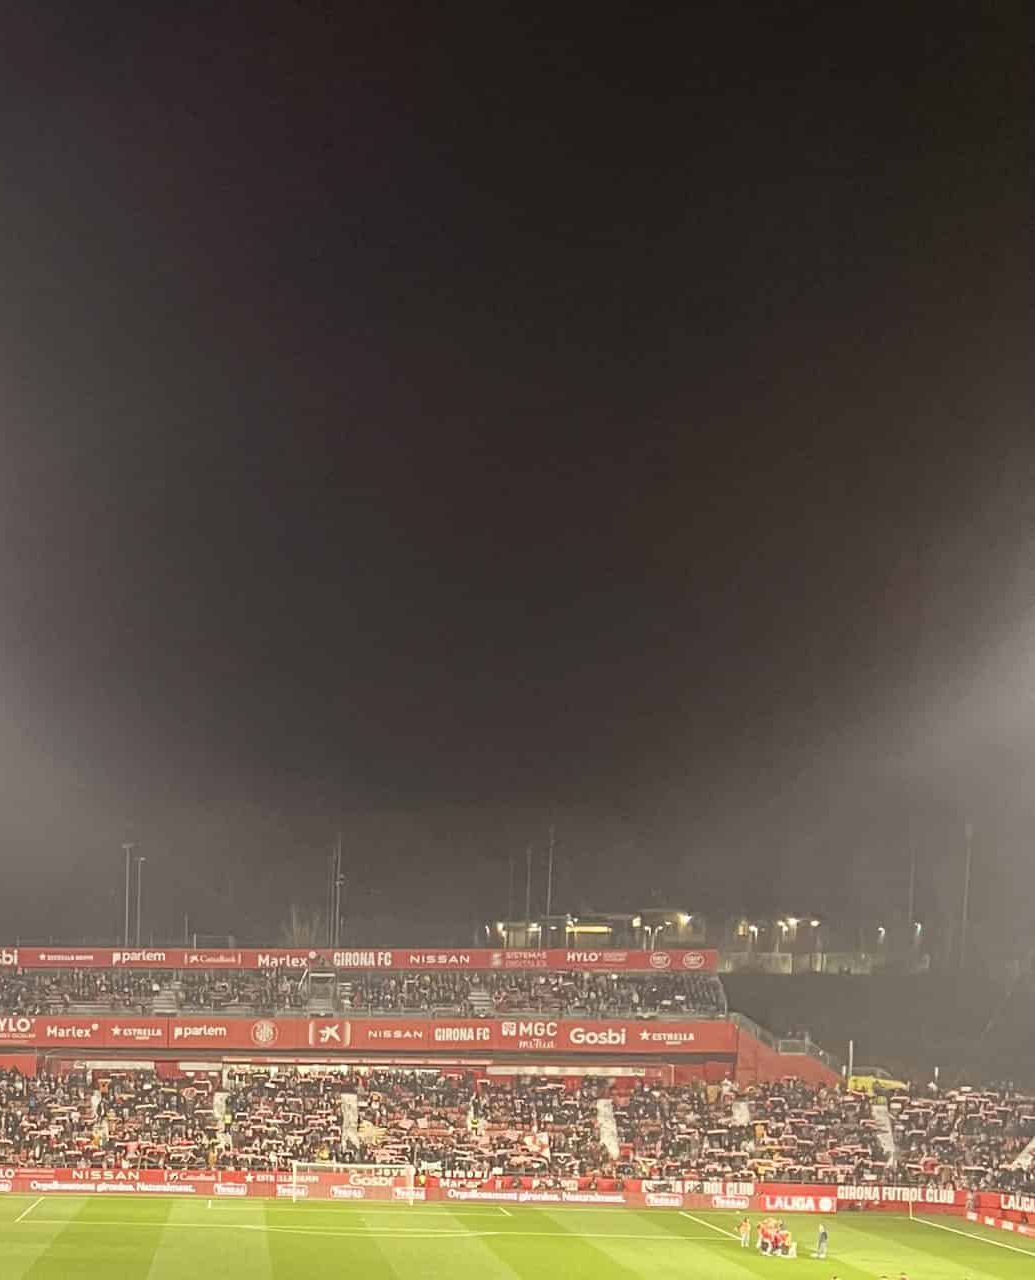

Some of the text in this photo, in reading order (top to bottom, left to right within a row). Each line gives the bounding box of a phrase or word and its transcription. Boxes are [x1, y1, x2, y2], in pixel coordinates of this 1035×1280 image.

[257, 954, 307, 967] Marlex
[333, 952, 392, 966] GIRONA FC
[409, 955, 470, 963] NISSAN
[566, 952, 599, 962] HYLO
[46, 1025, 92, 1038] Marlex
[123, 1029, 162, 1037] ESTRELLA
[367, 1031, 423, 1039] NISSAN
[434, 1028, 490, 1041] GIRONA FC
[518, 1022, 557, 1036] MGC
[569, 1028, 626, 1045] Gosbi
[652, 1033, 695, 1041] ESTRELLA
[71, 1171, 140, 1180] NISSAN
[837, 1185, 954, 1203] GIRONA FUTBOL CLUB
[765, 1196, 815, 1210] LALIGA
